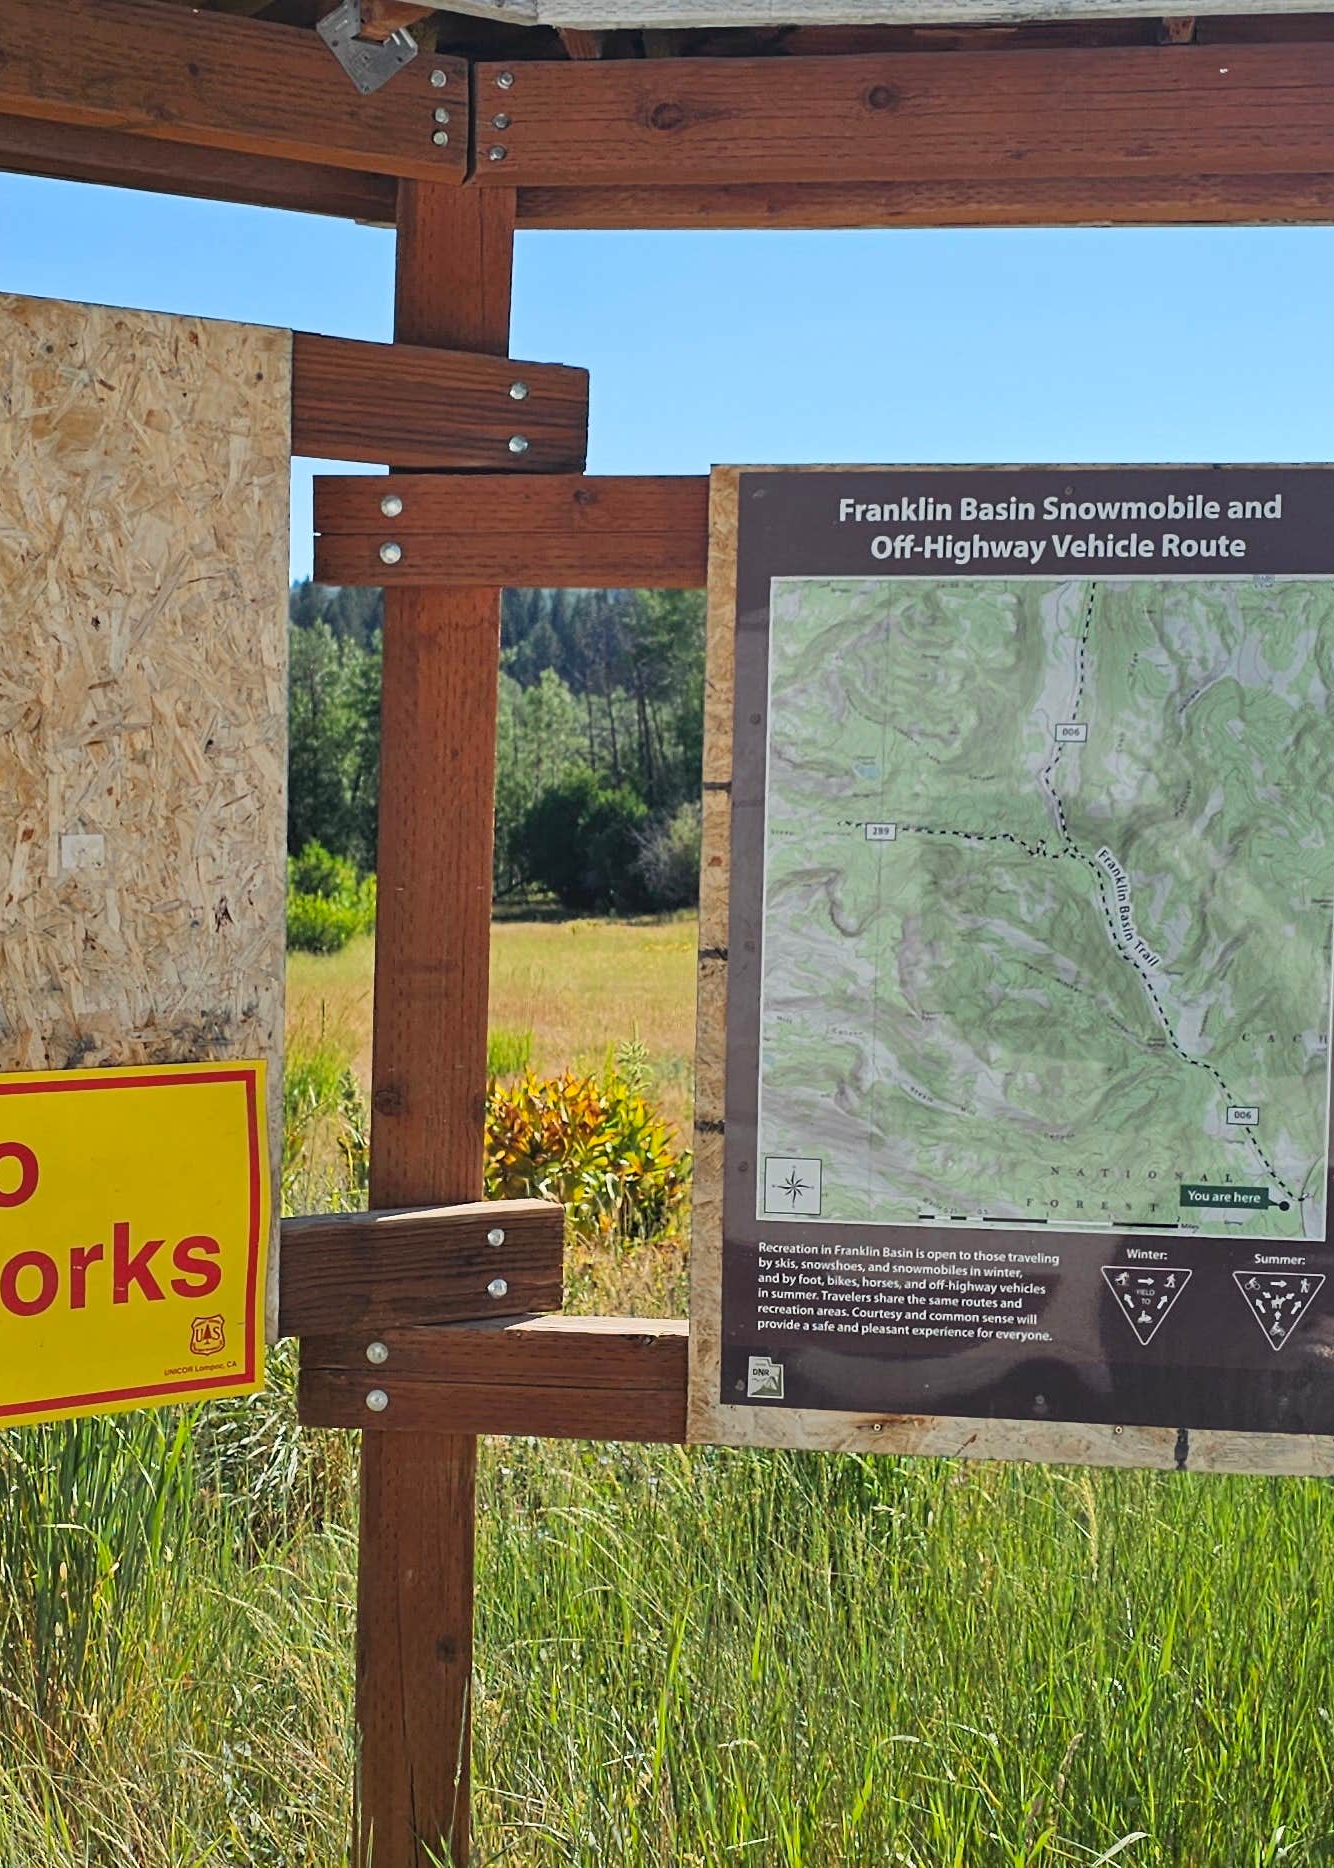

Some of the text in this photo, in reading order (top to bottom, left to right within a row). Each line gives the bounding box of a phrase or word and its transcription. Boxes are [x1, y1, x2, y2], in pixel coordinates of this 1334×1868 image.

[838, 495, 1282, 522] Franklin Basin Snowmobile and
[870, 534, 1247, 563] Off-Highway Vehicle Route
[1098, 850, 1159, 966] Franklin Basin Trail
[1187, 1190, 1261, 1204] You are here
[759, 1242, 1060, 1266] Recreation in Franklin Basin is open to those traveling
[1126, 1248, 1168, 1261] Winter:
[1254, 1253, 1306, 1265] Summer:
[757, 1319, 1053, 1342] provide a safe and pleasant experience for everyone.
[226, 1360, 237, 1368] CA
[752, 1368, 770, 1376] DNR
